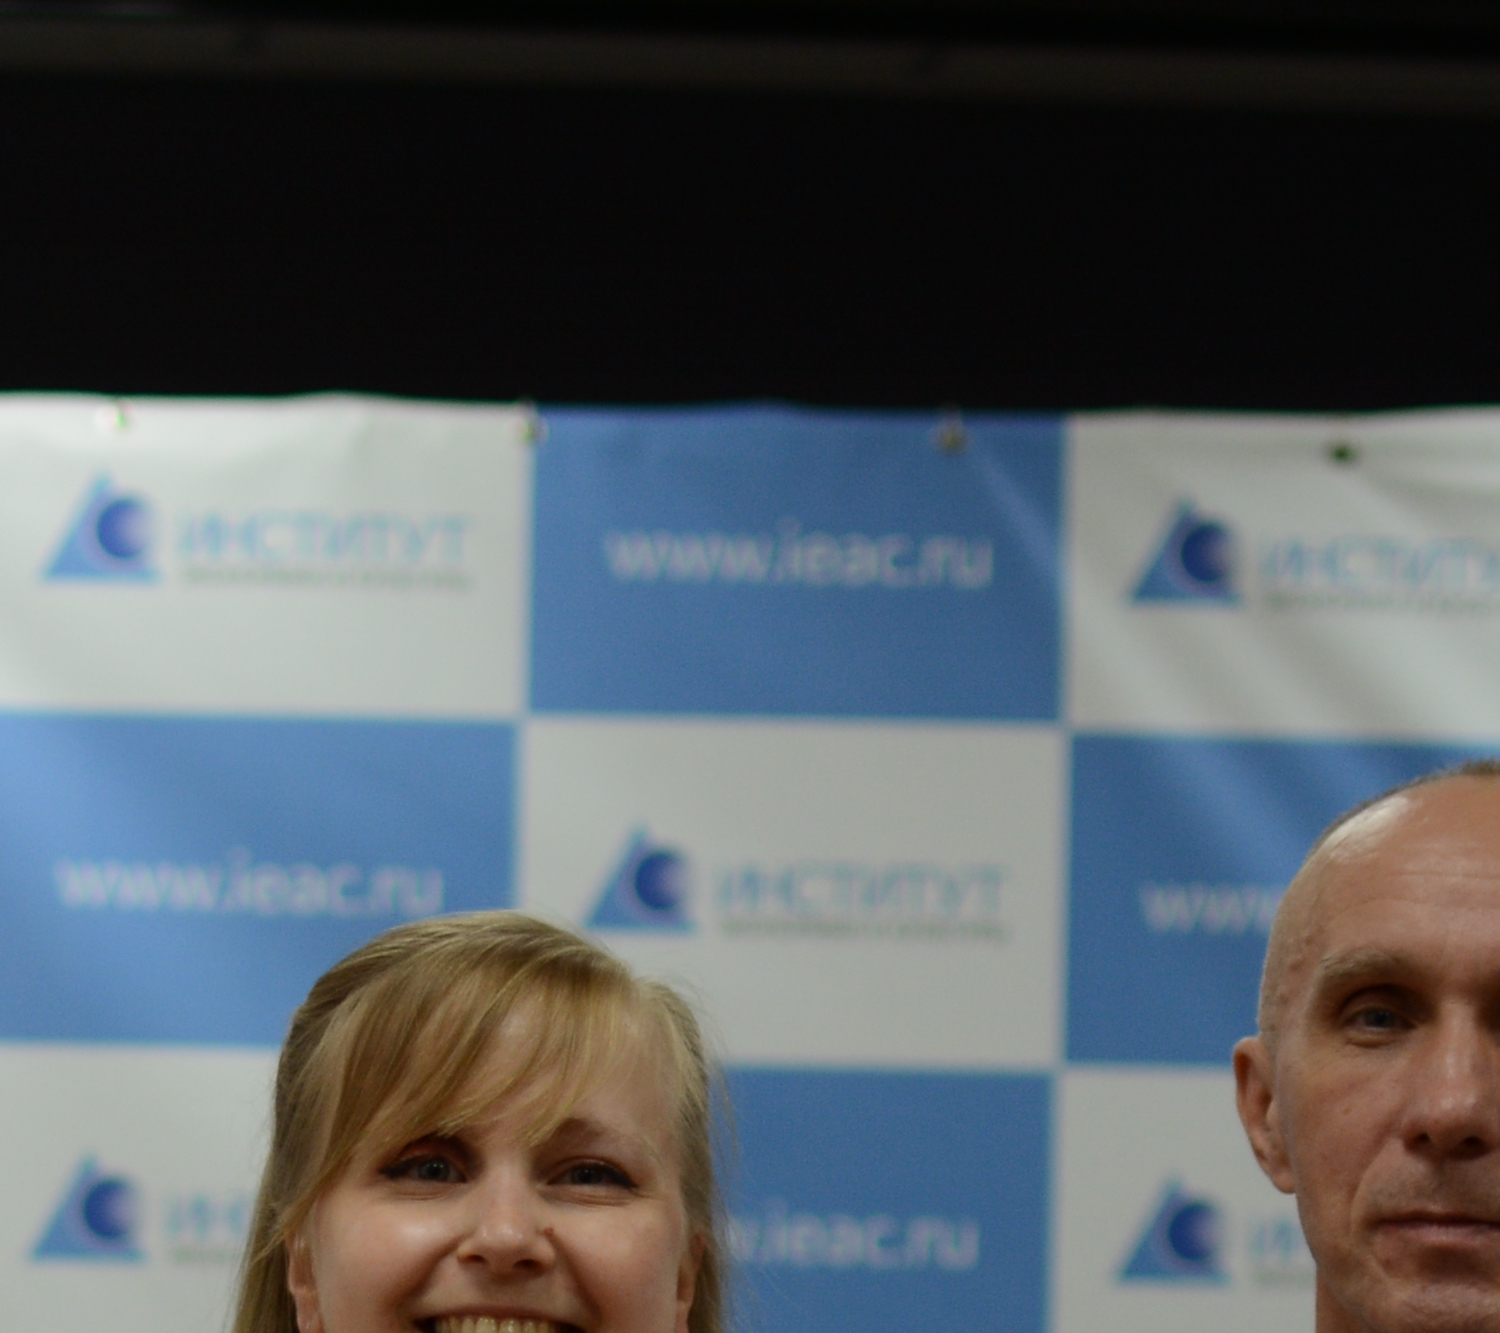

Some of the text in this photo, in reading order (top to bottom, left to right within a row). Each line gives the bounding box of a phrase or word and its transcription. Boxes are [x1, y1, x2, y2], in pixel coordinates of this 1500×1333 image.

[177, 509, 473, 562] ИНСТИТУТ
[603, 519, 993, 587] www.ieac.ru
[53, 851, 444, 917] www.ieac.ru
[716, 860, 1009, 917] ИНСТИТУТ
